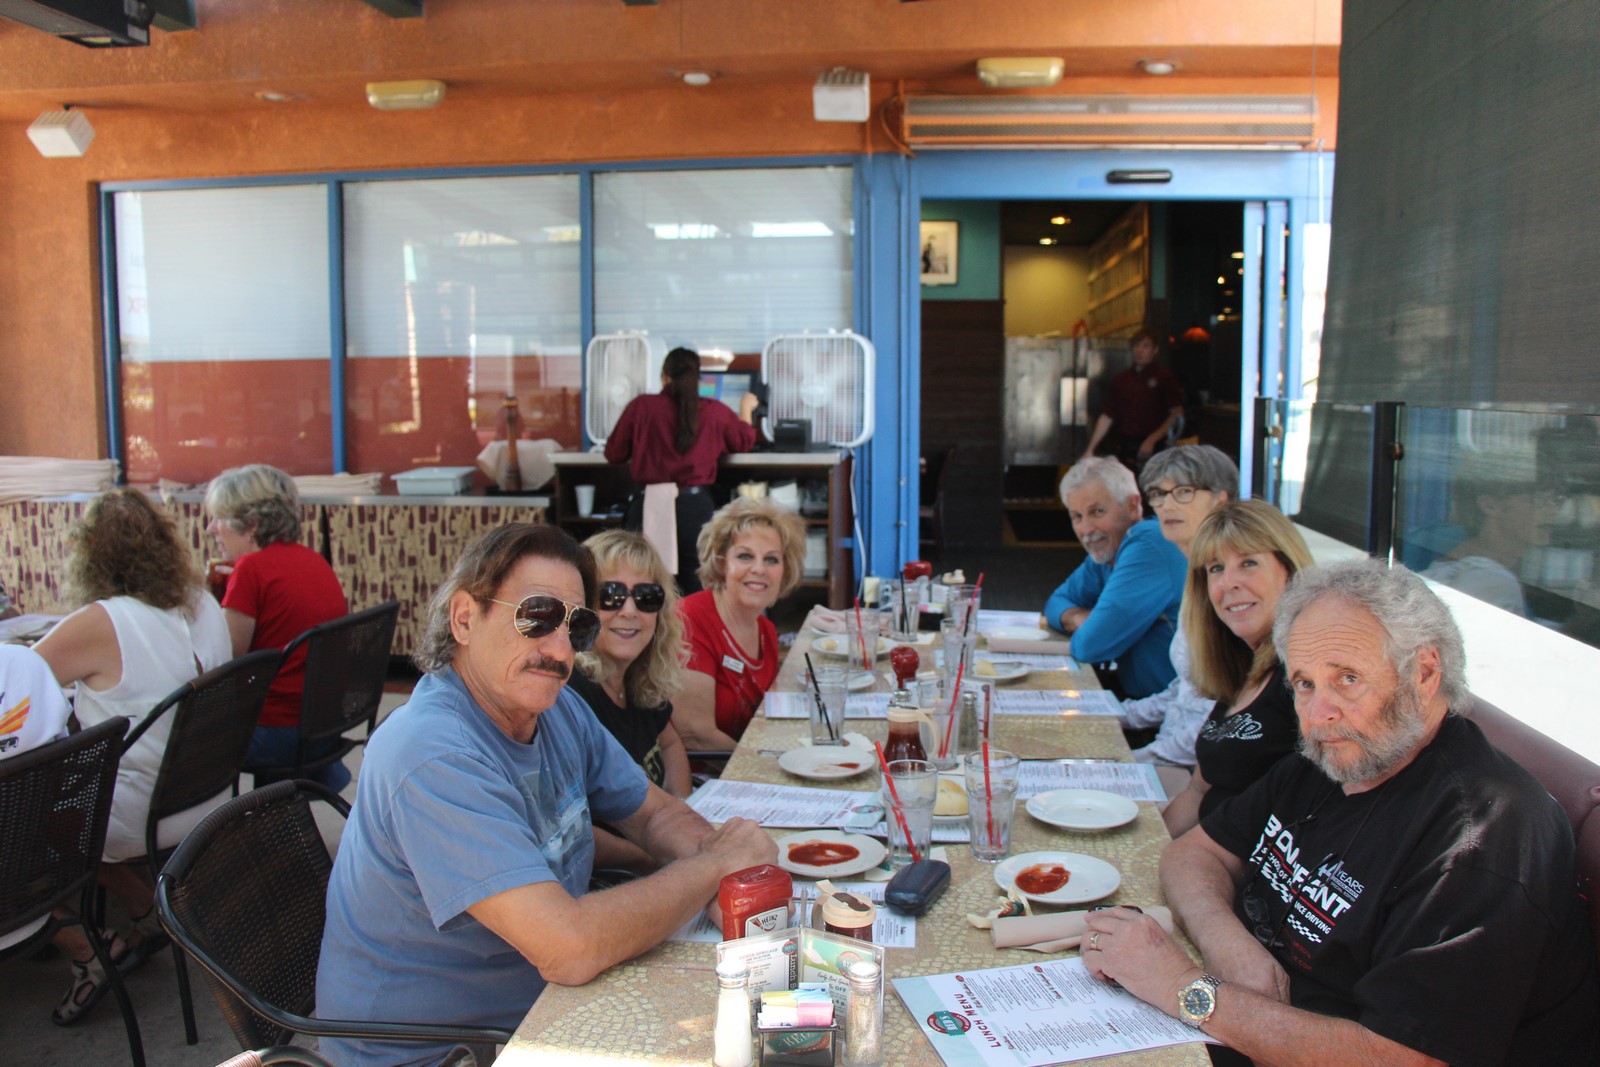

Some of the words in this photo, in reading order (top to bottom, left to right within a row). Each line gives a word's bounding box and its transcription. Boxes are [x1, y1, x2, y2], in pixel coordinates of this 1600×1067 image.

[1336, 870, 1365, 894] YEARS
[762, 914, 778, 925] HEINZ
[1304, 911, 1332, 935] DRIVING
[790, 954, 798, 981] Lunch
[954, 993, 977, 1016] MENU
[973, 1019, 1001, 1048] LUNCH
